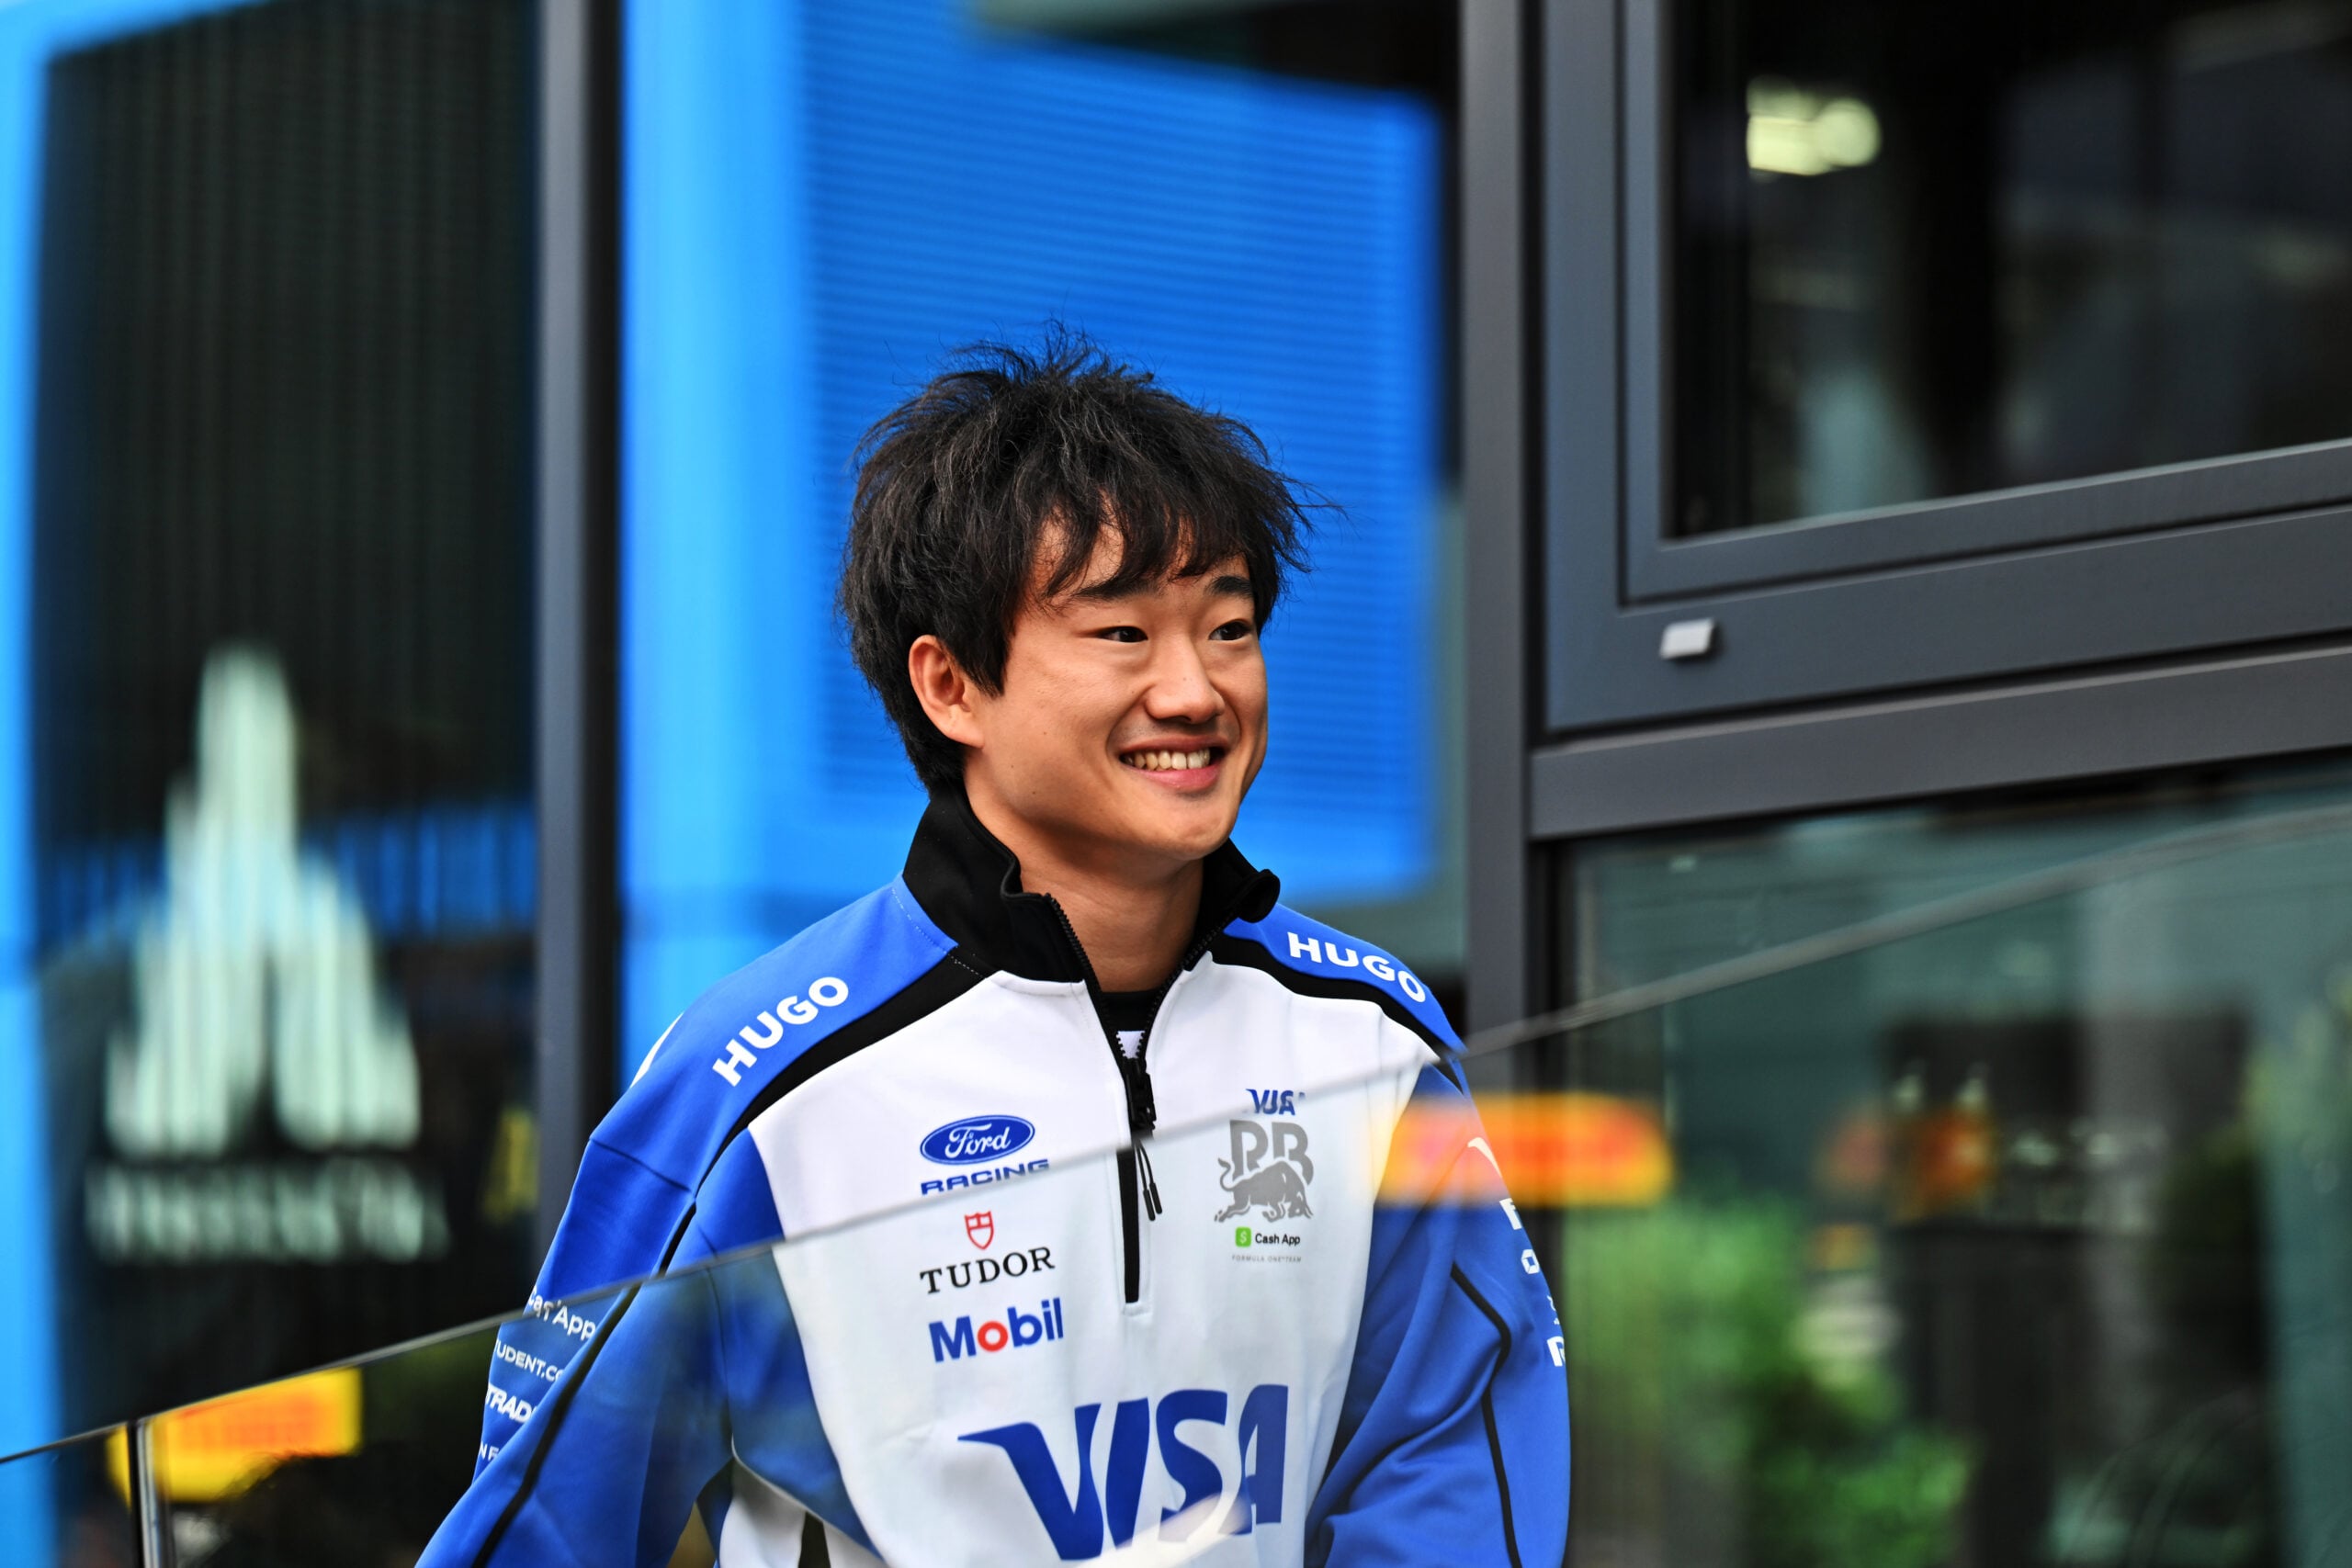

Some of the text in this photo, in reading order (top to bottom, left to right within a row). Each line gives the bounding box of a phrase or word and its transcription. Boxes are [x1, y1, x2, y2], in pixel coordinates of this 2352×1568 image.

[1287, 931, 1426, 1003] HUGO
[712, 976, 849, 1087] HUGO
[944, 1122, 1012, 1158] Ford
[921, 1159, 1049, 1195] RACING
[1255, 1233, 1301, 1247] Cash App
[920, 1247, 1055, 1294] TUDOR
[552, 1305, 596, 1341] App
[929, 1297, 1064, 1363] Mobil
[957, 1383, 1288, 1561] VISA
